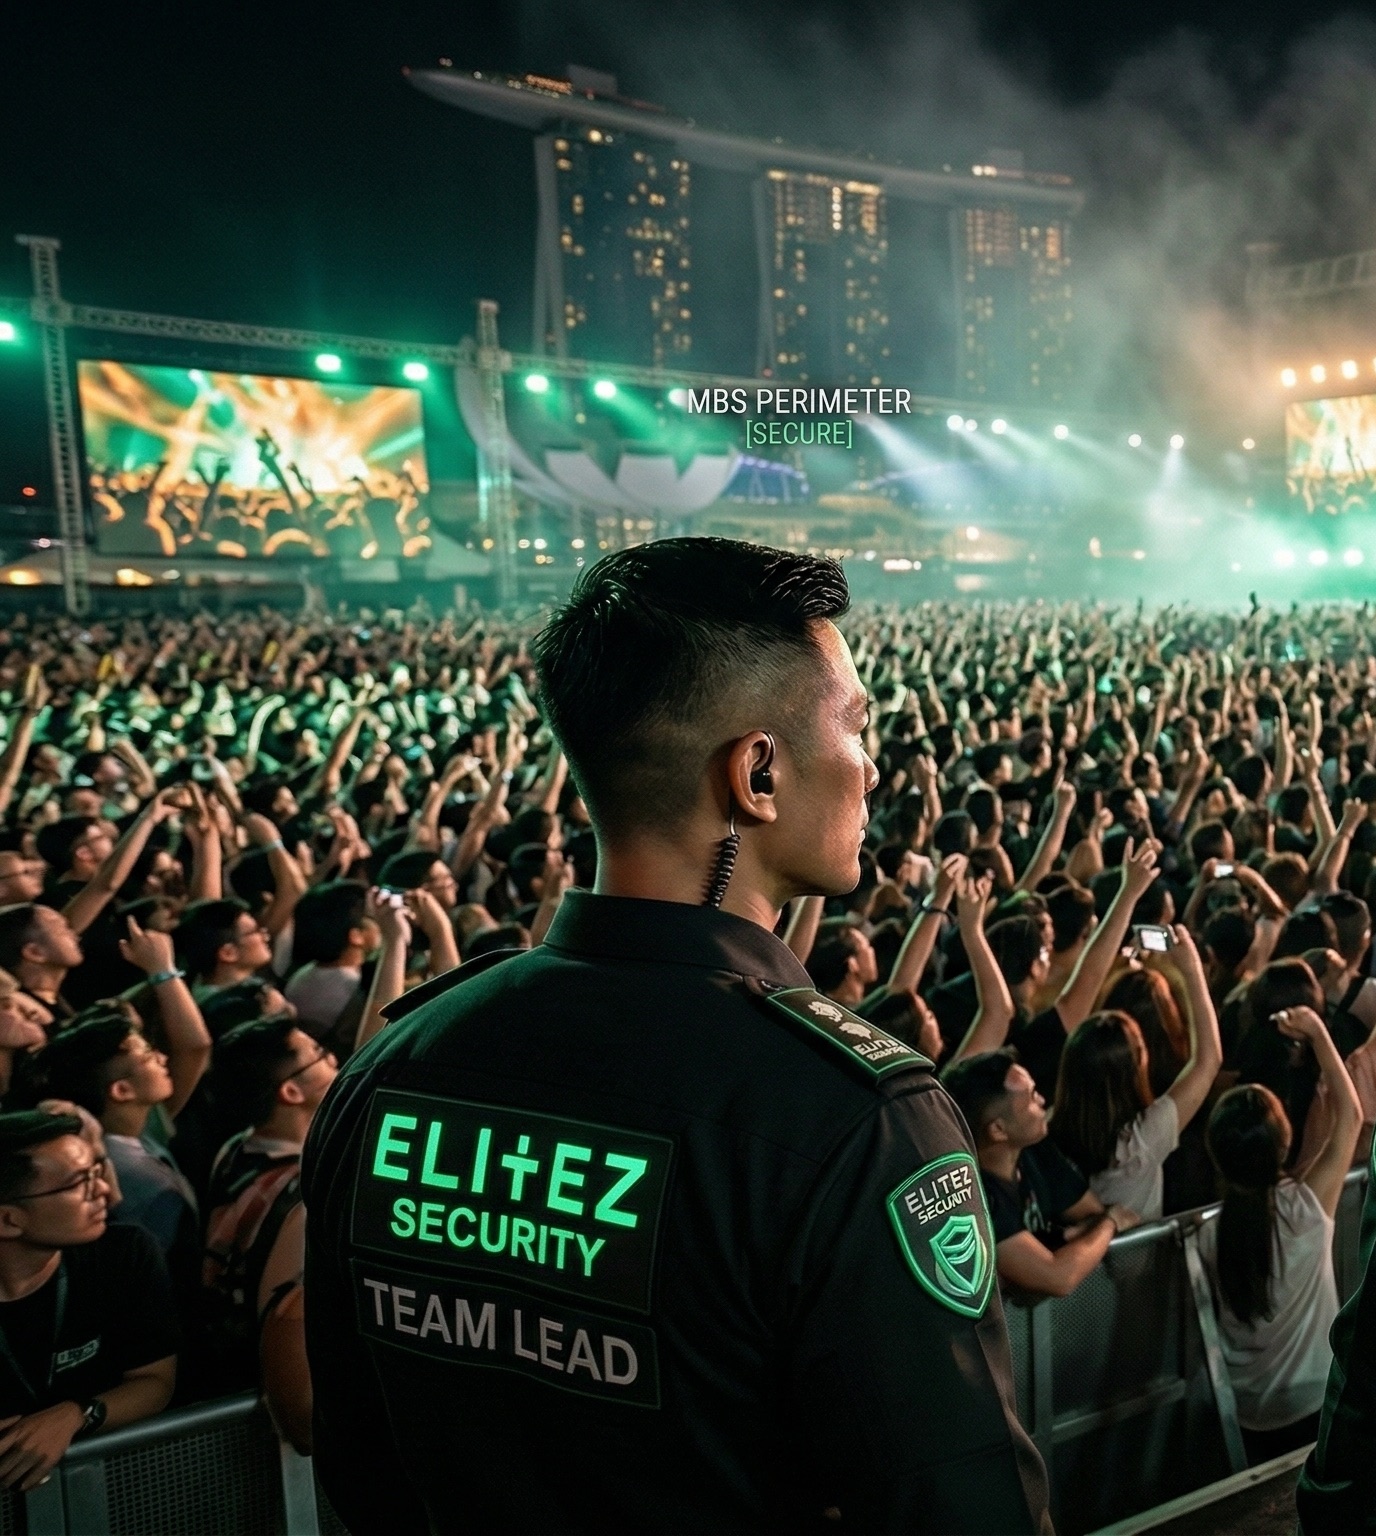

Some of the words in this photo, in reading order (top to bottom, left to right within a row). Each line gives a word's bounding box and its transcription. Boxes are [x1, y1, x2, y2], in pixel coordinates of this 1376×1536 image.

[904, 1165, 972, 1214] ELITEZ
[390, 1198, 606, 1277] SECURITY
[364, 1278, 496, 1350] TEAM
[514, 1309, 638, 1385] LEAD
